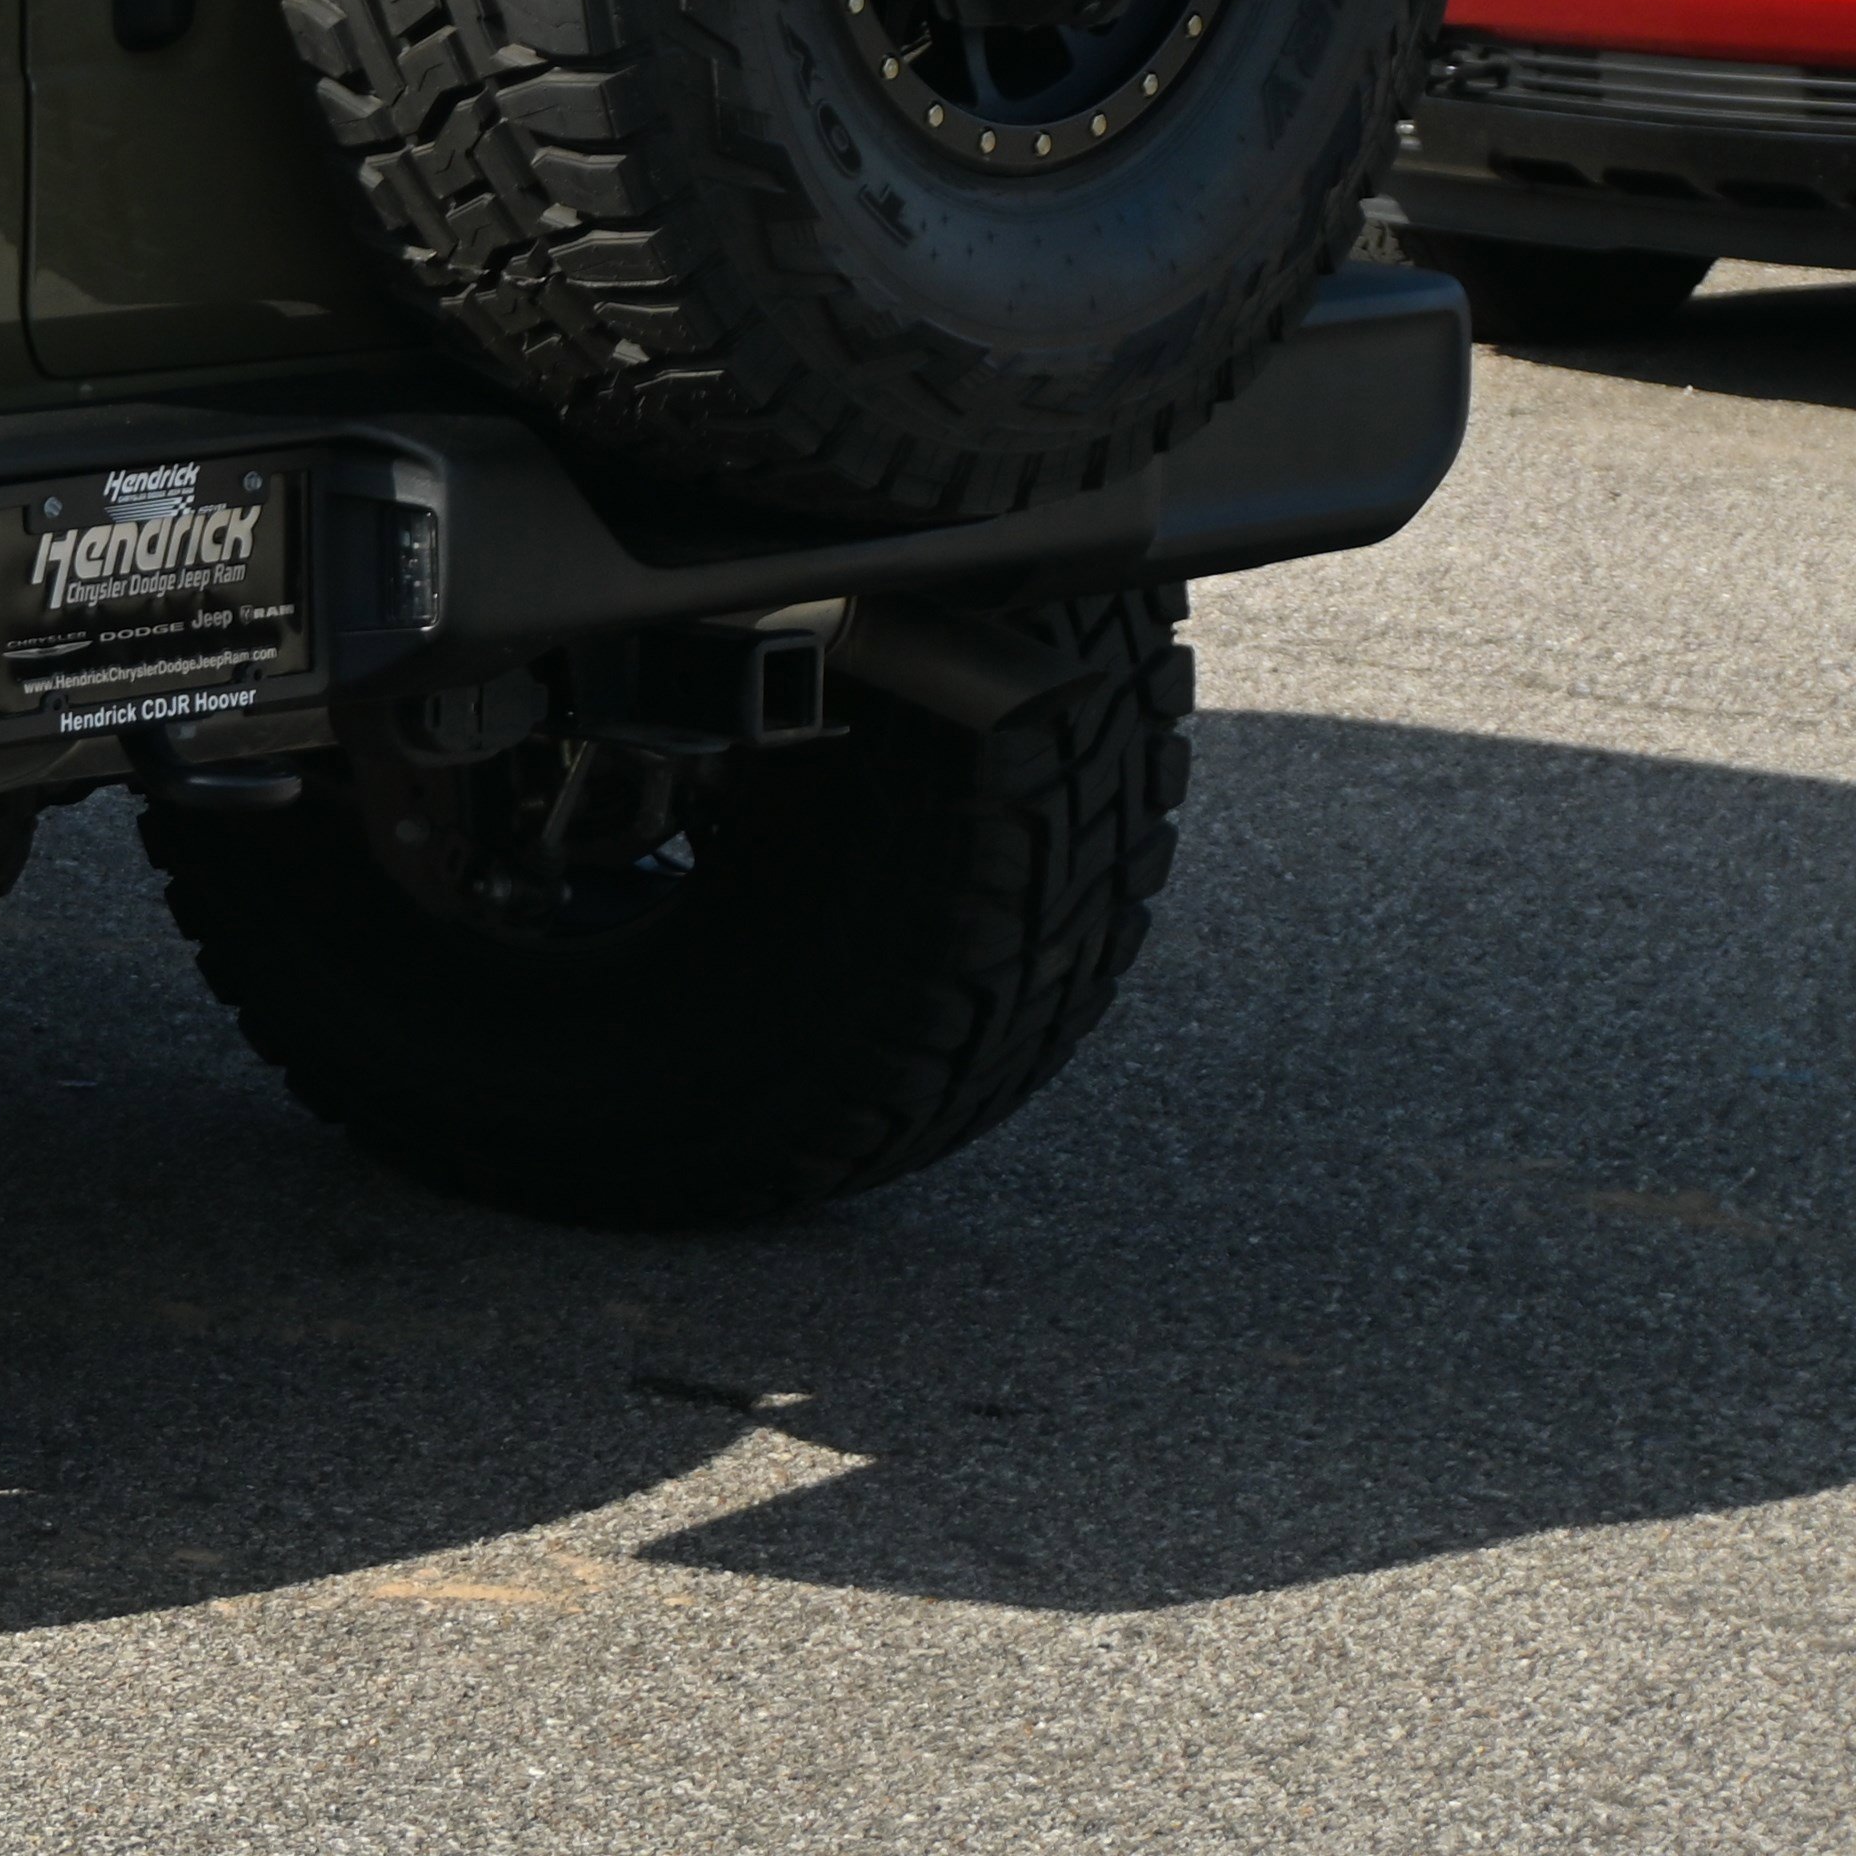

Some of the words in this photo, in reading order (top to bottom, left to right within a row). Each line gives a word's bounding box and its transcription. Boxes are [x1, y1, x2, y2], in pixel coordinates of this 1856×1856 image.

[103, 461, 200, 502] Hendrick
[31, 505, 265, 609] Hendrick
[66, 578, 127, 607] Chrysler
[130, 572, 176, 598] Dodge
[178, 568, 210, 592] Jeep
[213, 563, 246, 584] Ram
[7, 630, 87, 647] CHRYSLER
[99, 621, 185, 642] DODGE
[192, 609, 233, 630] Jeep
[253, 604, 295, 619] RAM
[23, 646, 278, 695] www.HendrickChryslerDodgeJeepRam.com
[60, 703, 137, 732] Hendrick
[141, 694, 191, 721] CDJR
[194, 689, 257, 714] Hoover
